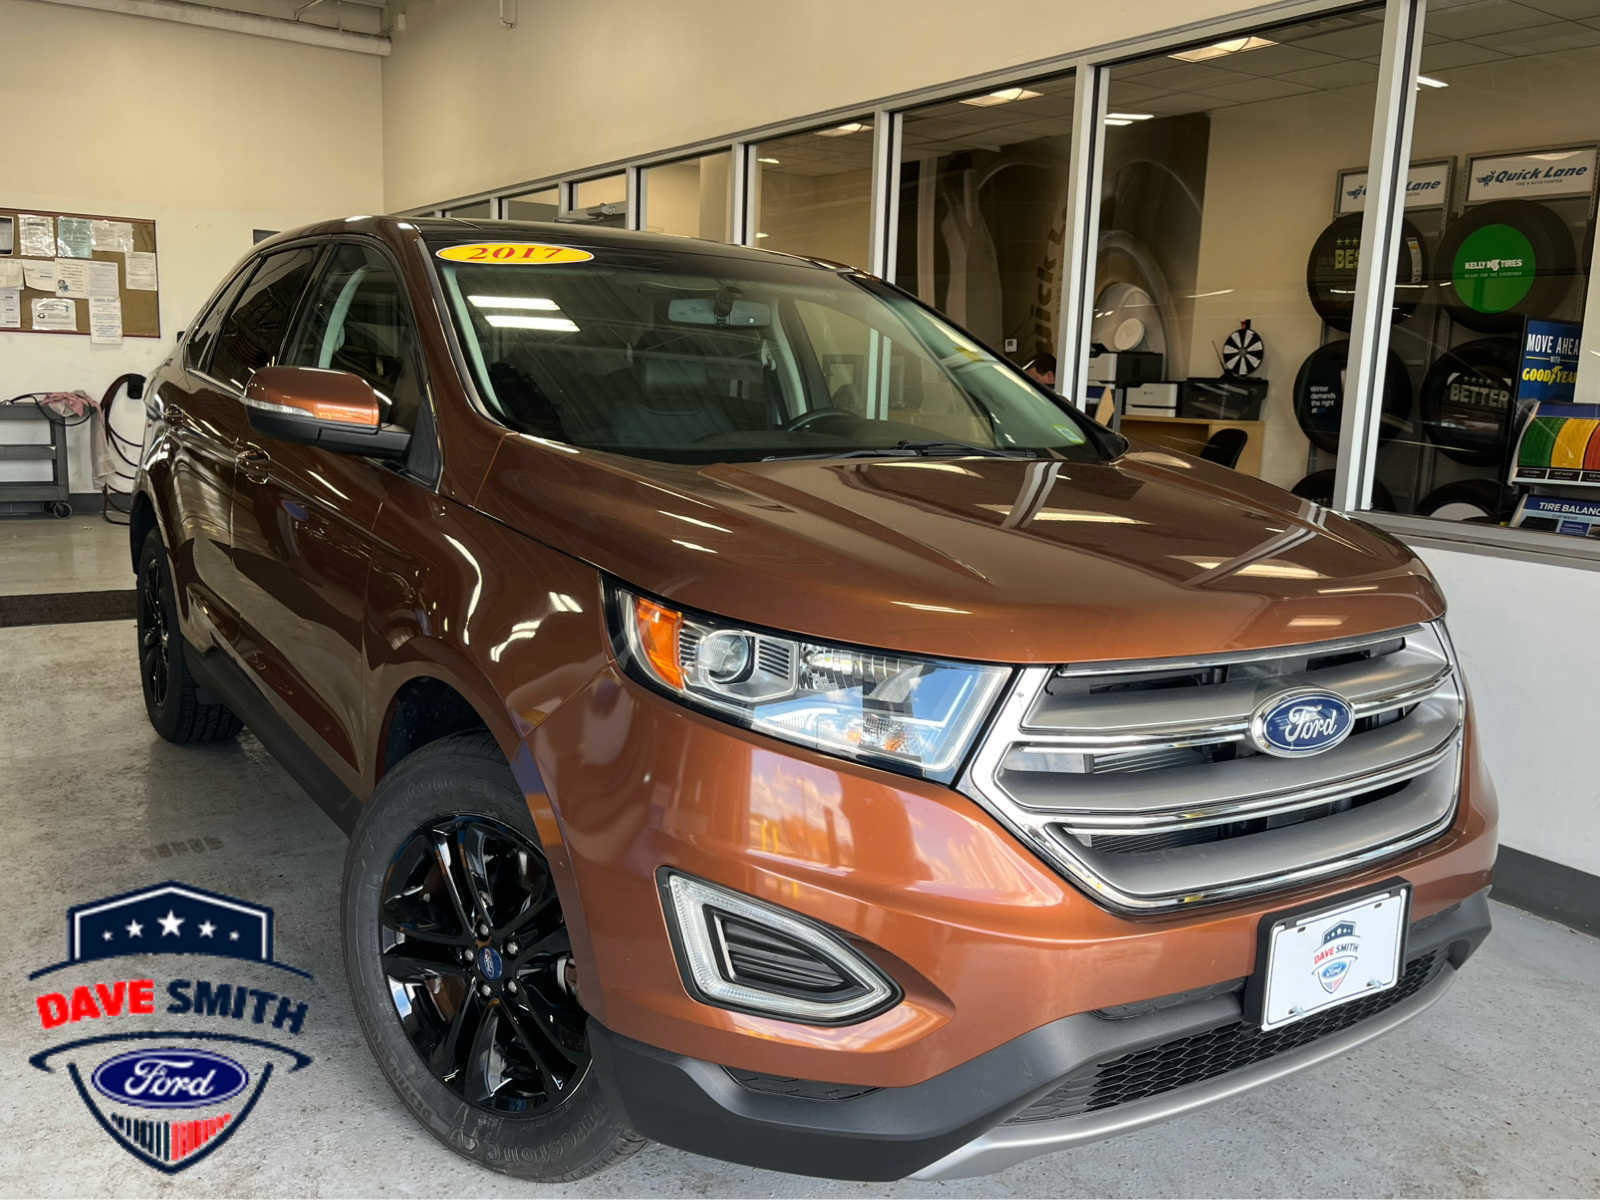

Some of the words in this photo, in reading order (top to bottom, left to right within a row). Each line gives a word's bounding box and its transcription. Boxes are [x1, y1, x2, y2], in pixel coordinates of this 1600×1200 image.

[1495, 168, 1542, 183] Quick
[1543, 165, 1588, 178] Lane
[466, 247, 563, 260] 2017
[1526, 333, 1554, 353] MOVE
[1450, 383, 1510, 408] BETTER
[1539, 502, 1561, 512] TIRE
[1285, 704, 1337, 742] Ford
[1314, 946, 1335, 965] DAVE
[1336, 943, 1359, 953] SMITH
